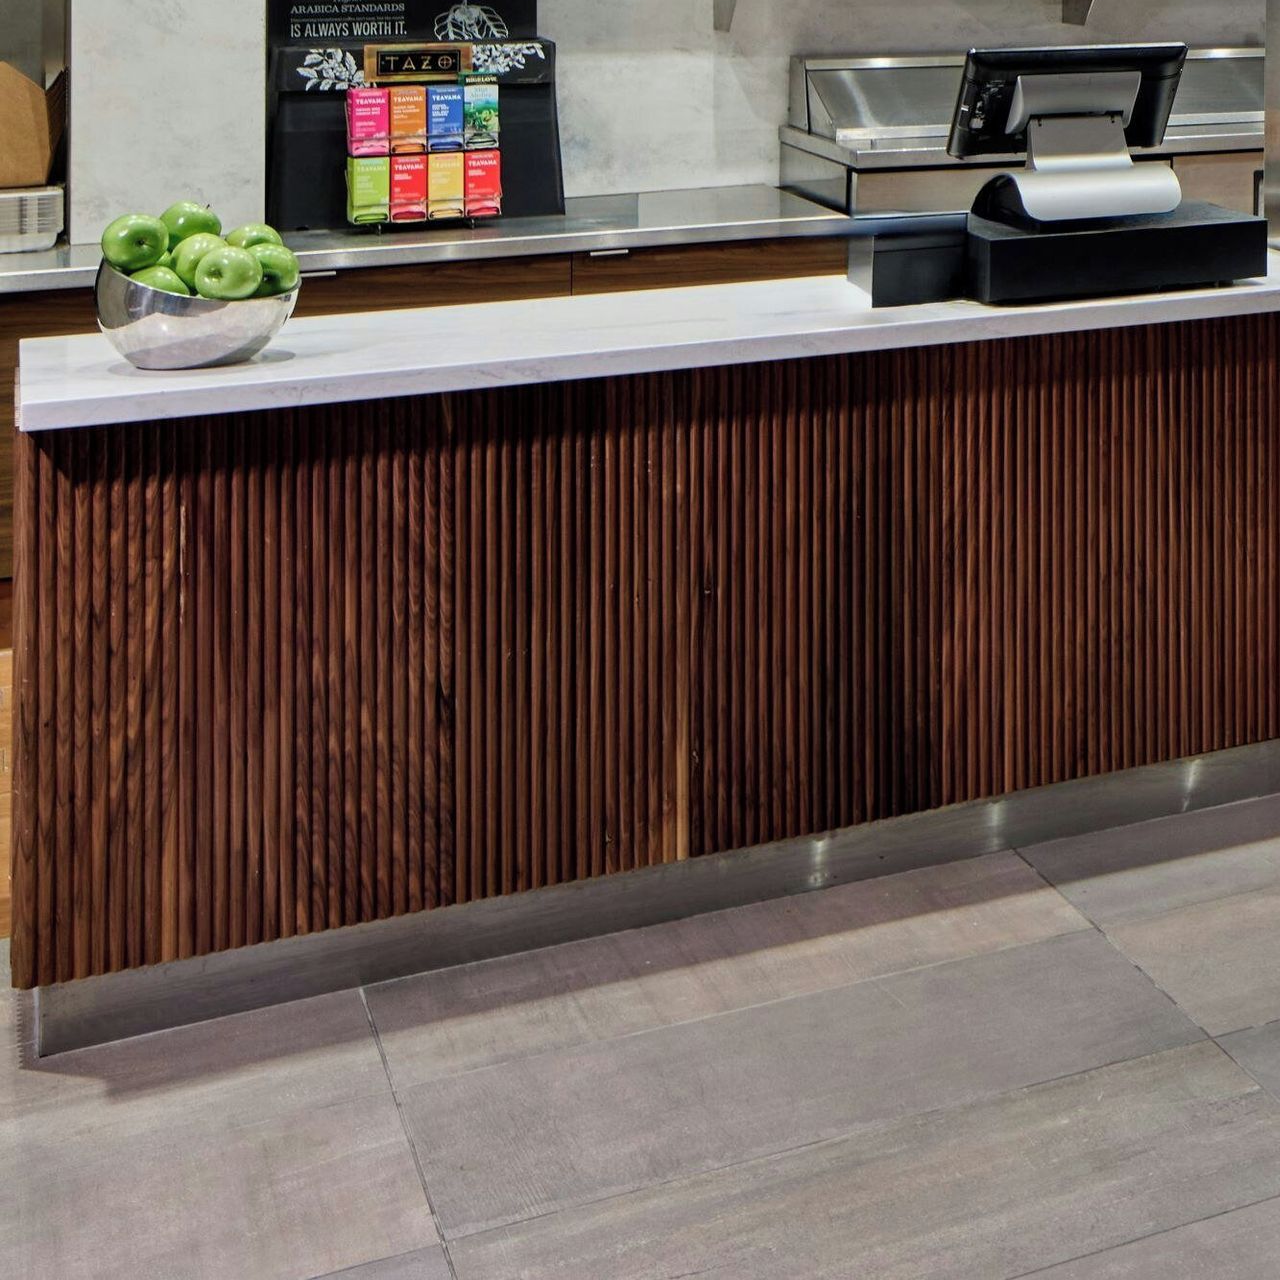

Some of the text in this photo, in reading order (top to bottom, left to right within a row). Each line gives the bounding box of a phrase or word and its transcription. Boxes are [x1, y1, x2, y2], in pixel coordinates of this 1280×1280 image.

[290, 2, 405, 15] ARABICA STANDARDS
[290, 20, 408, 38] IS ALWAYS WORTH IT.
[385, 55, 455, 71] TAZO
[355, 98, 386, 106] TEAVANA
[393, 95, 424, 104] TEAVANA
[431, 94, 462, 102] TEAVANA
[394, 164, 425, 172] TEAVANA
[468, 159, 498, 168] TEAVANA
